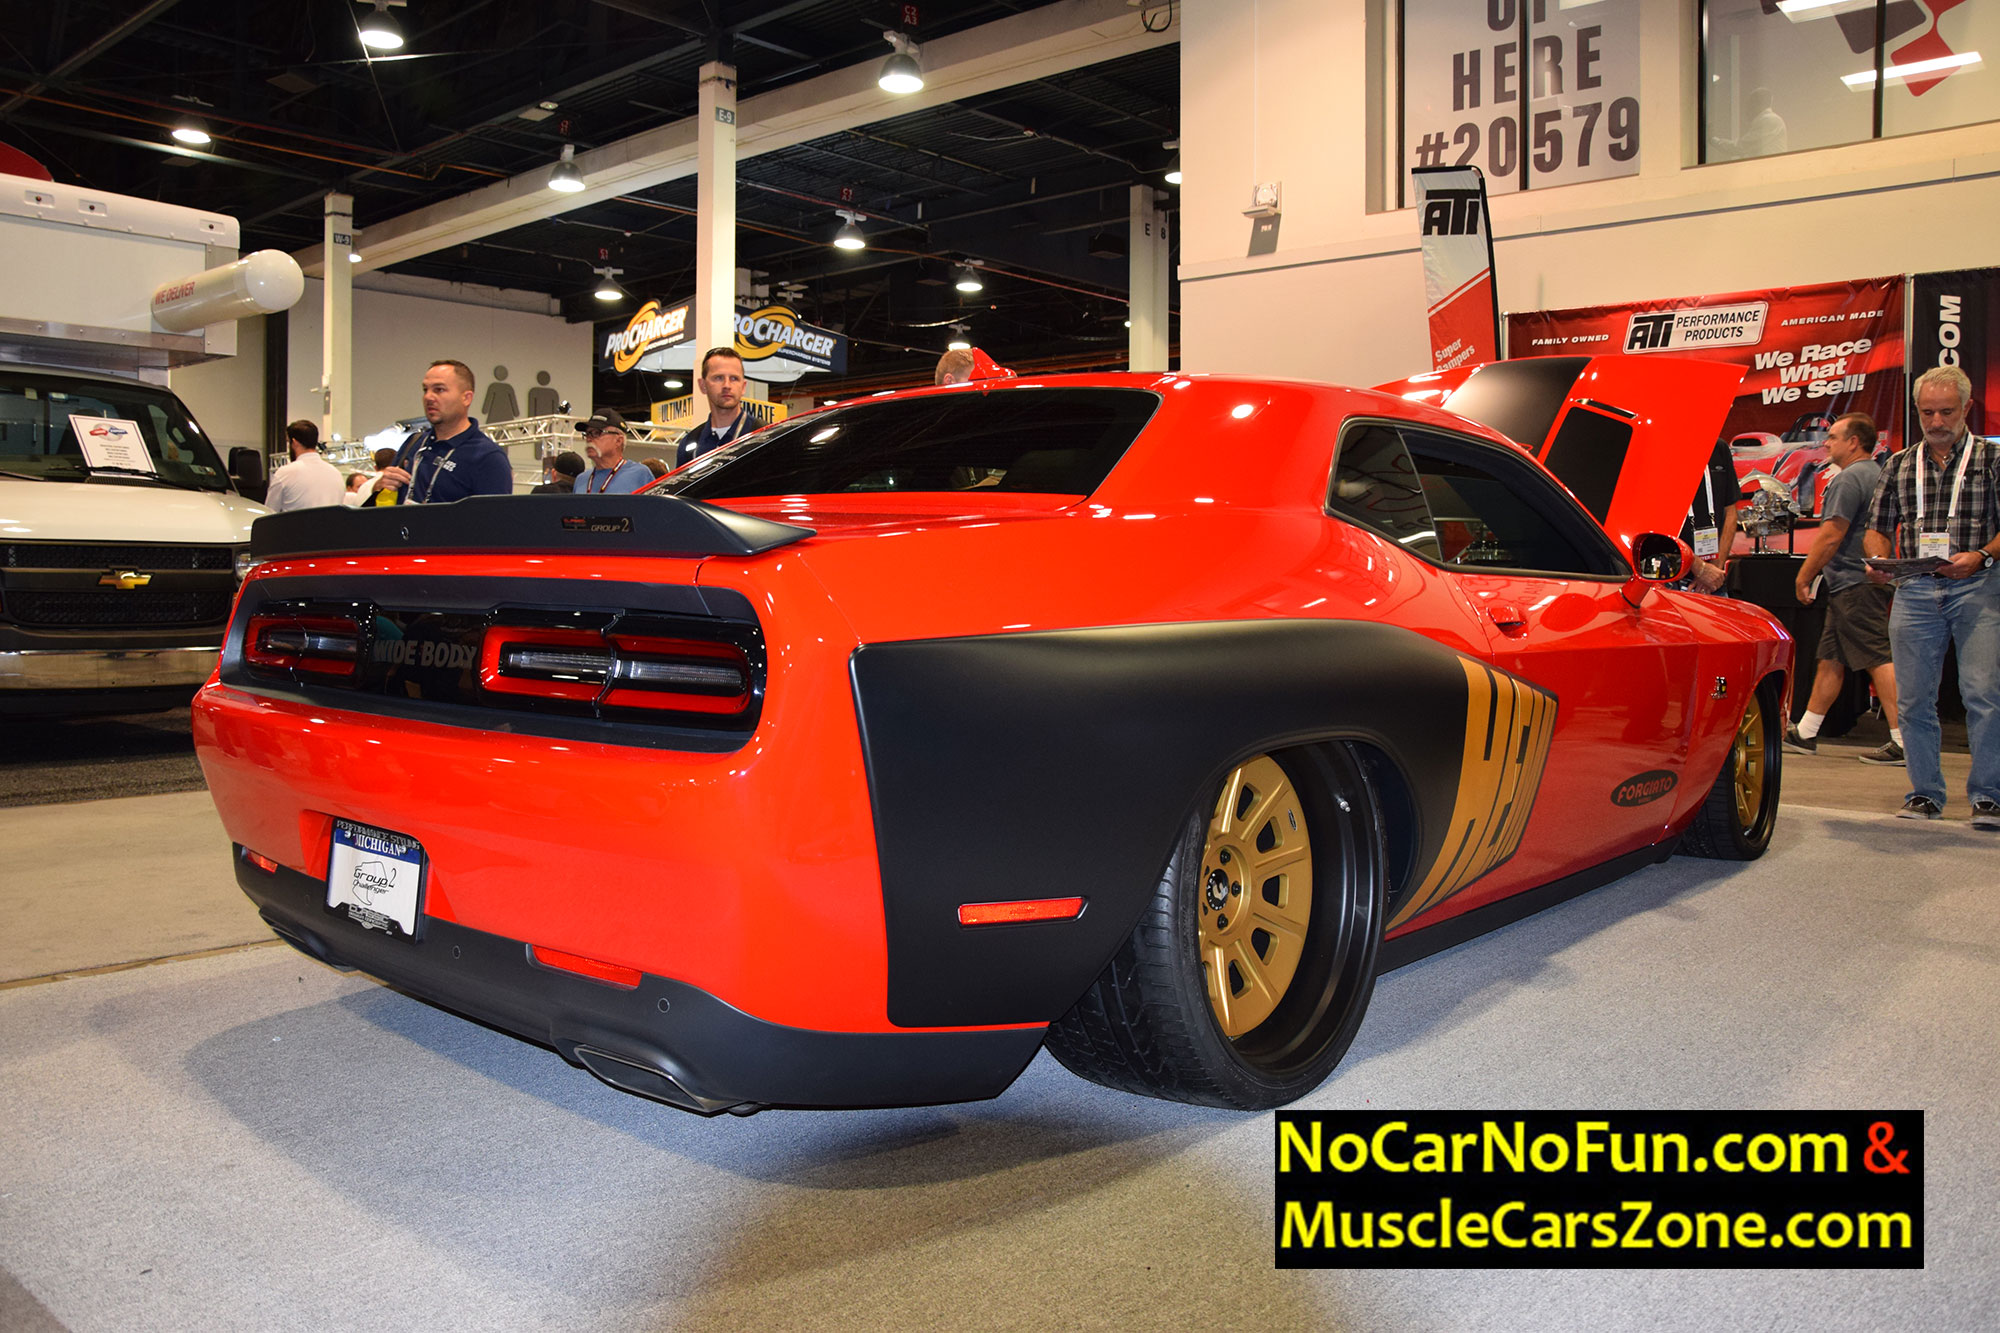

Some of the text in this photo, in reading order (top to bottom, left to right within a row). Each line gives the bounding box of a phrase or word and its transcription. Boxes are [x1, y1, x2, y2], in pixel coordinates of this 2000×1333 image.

[1453, 25, 1602, 112] HERE
[719, 109, 732, 123] E-9
[1415, 96, 1640, 178] #20579
[1423, 189, 1481, 236] ATI
[155, 281, 196, 304] WE DELIVER
[1676, 309, 1761, 329] PERFORMANCE
[1781, 309, 1885, 327] AMERICAN MADE
[734, 313, 834, 357] ROCHARGER
[1531, 334, 1610, 346] FAMILY OWNED
[1627, 313, 1676, 350] ATI
[1684, 325, 1744, 342] PRODUCTS
[1435, 338, 1462, 362] Super
[1754, 338, 1873, 371] We Race
[1779, 357, 1848, 384] What
[1761, 373, 1867, 406] We Sell!
[591, 517, 630, 533] GROUP 2
[373, 639, 478, 670] WIDE BODY
[1617, 775, 1673, 804] FORGIATO
[354, 833, 402, 857] MICHIGAN
[353, 867, 397, 888] Group 2
